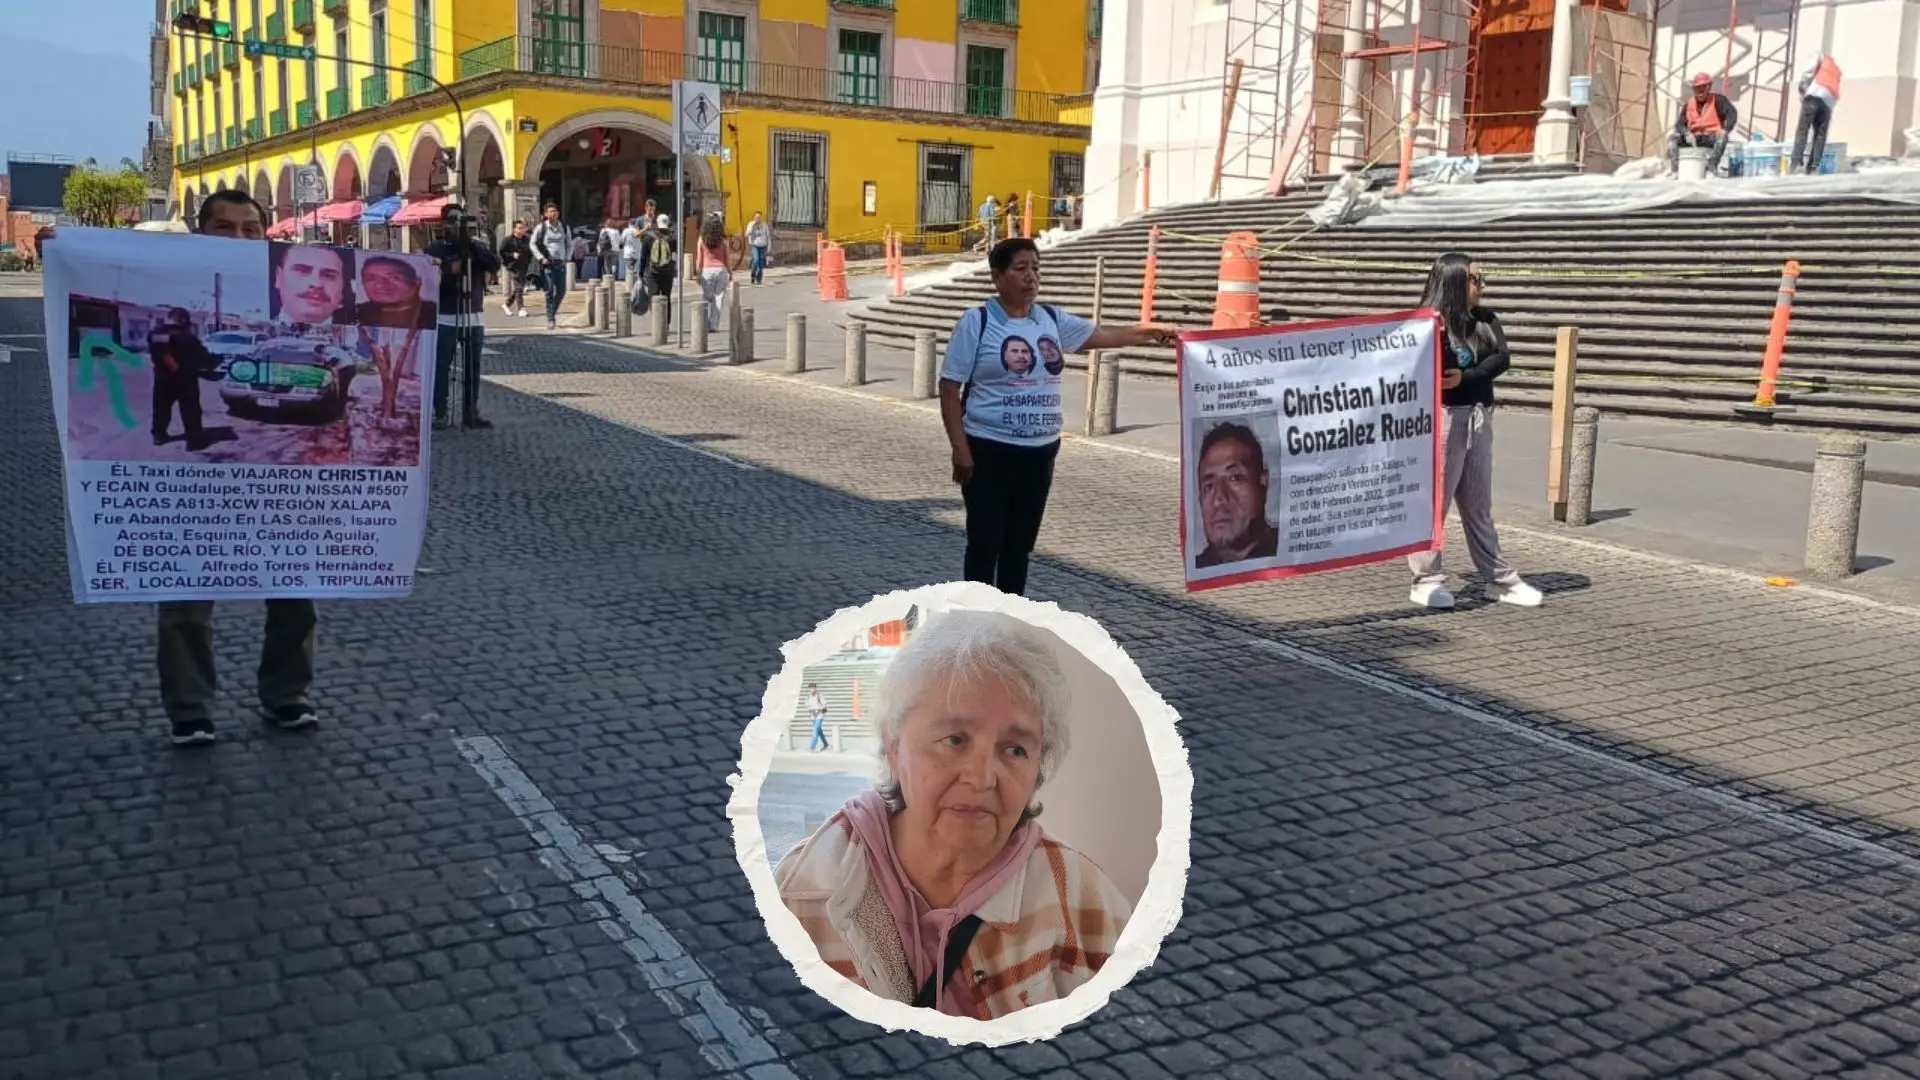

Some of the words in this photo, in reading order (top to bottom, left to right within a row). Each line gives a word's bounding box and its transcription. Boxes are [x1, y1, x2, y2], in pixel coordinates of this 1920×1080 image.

[1206, 348, 1217, 368] 4
[1222, 347, 1263, 368] años
[1268, 340, 1294, 362] sin
[1300, 339, 1345, 359] tener
[1350, 328, 1418, 360] justicia
[1283, 381, 1374, 418] Christian
[1379, 374, 1417, 406] Iván
[1002, 412, 1013, 424] EL
[1017, 412, 1027, 425] 10
[1028, 413, 1040, 425] DE
[1286, 419, 1376, 456] González
[1380, 408, 1432, 442] Rueda
[110, 461, 132, 477] ÉL
[138, 465, 171, 478] Taxi
[175, 464, 226, 479] dónde
[230, 467, 313, 480] VIAJARON
[317, 469, 408, 483] CHRISTIAN
[80, 480, 92, 493] Y
[96, 480, 150, 493] ECAIN
[305, 484, 362, 496] NISSAN
[366, 485, 409, 496] #5507
[101, 497, 171, 509] PLACAS
[175, 498, 259, 510] A813-XCW
[263, 496, 325, 510] REGIÓN
[330, 500, 391, 511] XALAPA
[93, 513, 124, 525] Fue
[128, 512, 231, 525] Abandonado
[235, 514, 256, 525] En
[261, 514, 292, 526] LAS
[297, 514, 346, 527] Calles,
[351, 515, 397, 526] Isauro
[116, 529, 178, 542] Acosta,
[183, 529, 251, 543] Esquina,
[255, 529, 319, 541] Cándido
[322, 529, 380, 543] Aguilar,
[113, 542, 137, 557] DÉ
[142, 544, 191, 557] BOCA
[196, 544, 229, 556] DEL
[233, 542, 266, 557] RÍO,
[270, 544, 281, 556] Y
[285, 545, 307, 556] LO
[316, 543, 379, 557] LIBERÓ,
[96, 559, 117, 574] ÉL
[201, 560, 259, 572] Alfredo
[263, 560, 310, 572] Torres
[315, 560, 394, 572] Hernández
[90, 577, 130, 591] SER,
[139, 576, 262, 589] LOCALIZADOS,
[272, 575, 308, 588] LOS,
